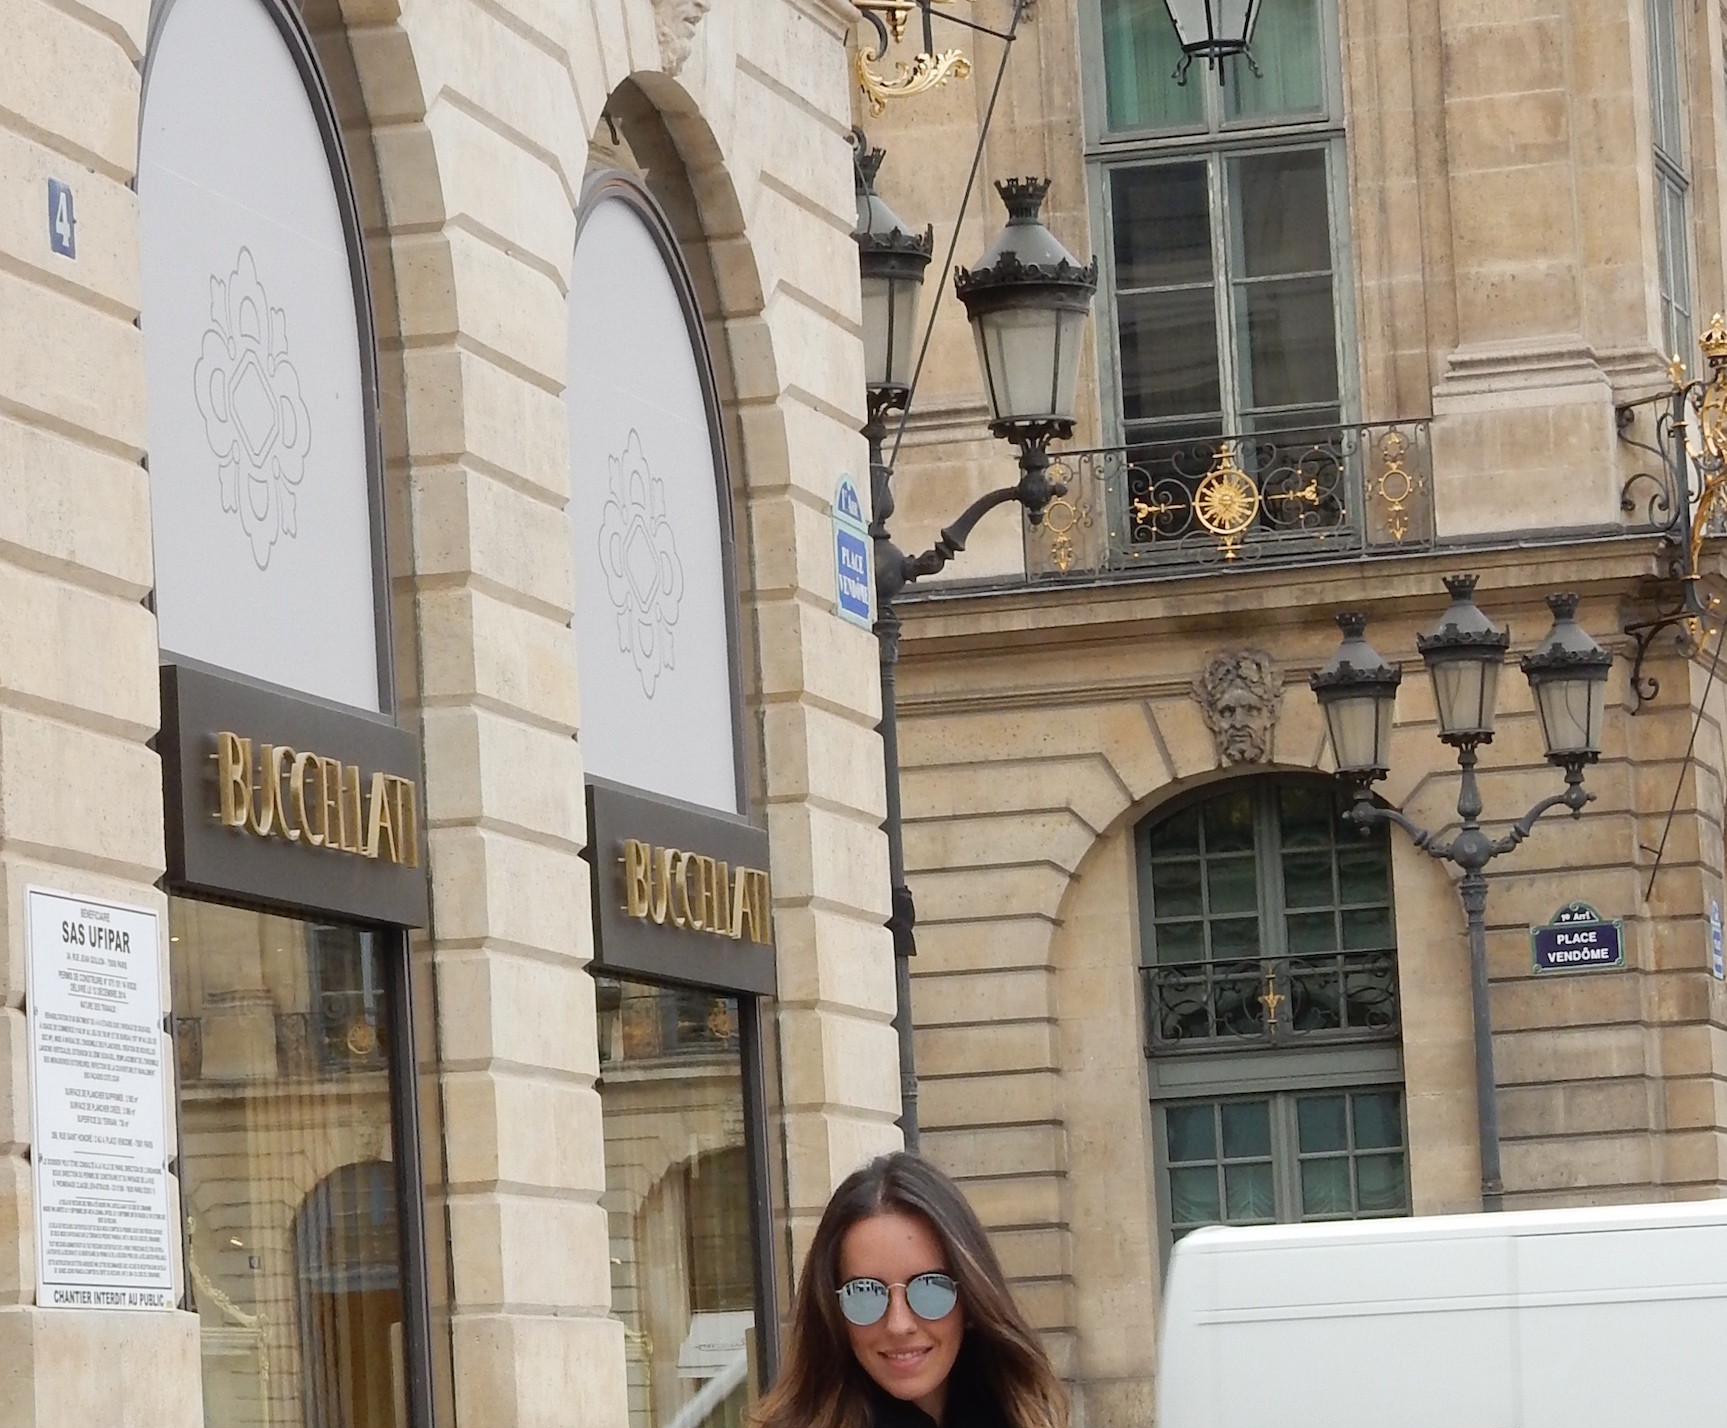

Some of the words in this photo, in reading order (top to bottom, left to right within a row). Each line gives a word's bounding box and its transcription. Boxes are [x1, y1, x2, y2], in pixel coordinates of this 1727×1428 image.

[56, 192, 71, 248] 4
[841, 546, 864, 575] PLACE
[839, 573, 869, 604] VENDÔME
[217, 731, 419, 868] BUCCELLATI
[624, 838, 772, 945] BUCCELLATI
[62, 920, 85, 946] SAS
[88, 925, 131, 954] UFIPAR
[1556, 931, 1598, 945] PLACE
[1547, 947, 1610, 963] VENDÔME
[53, 1290, 92, 1304] CHANTIER
[93, 1291, 127, 1306] INTERDIT
[128, 1291, 138, 1306] AU
[139, 1293, 165, 1307] PUBLIC
